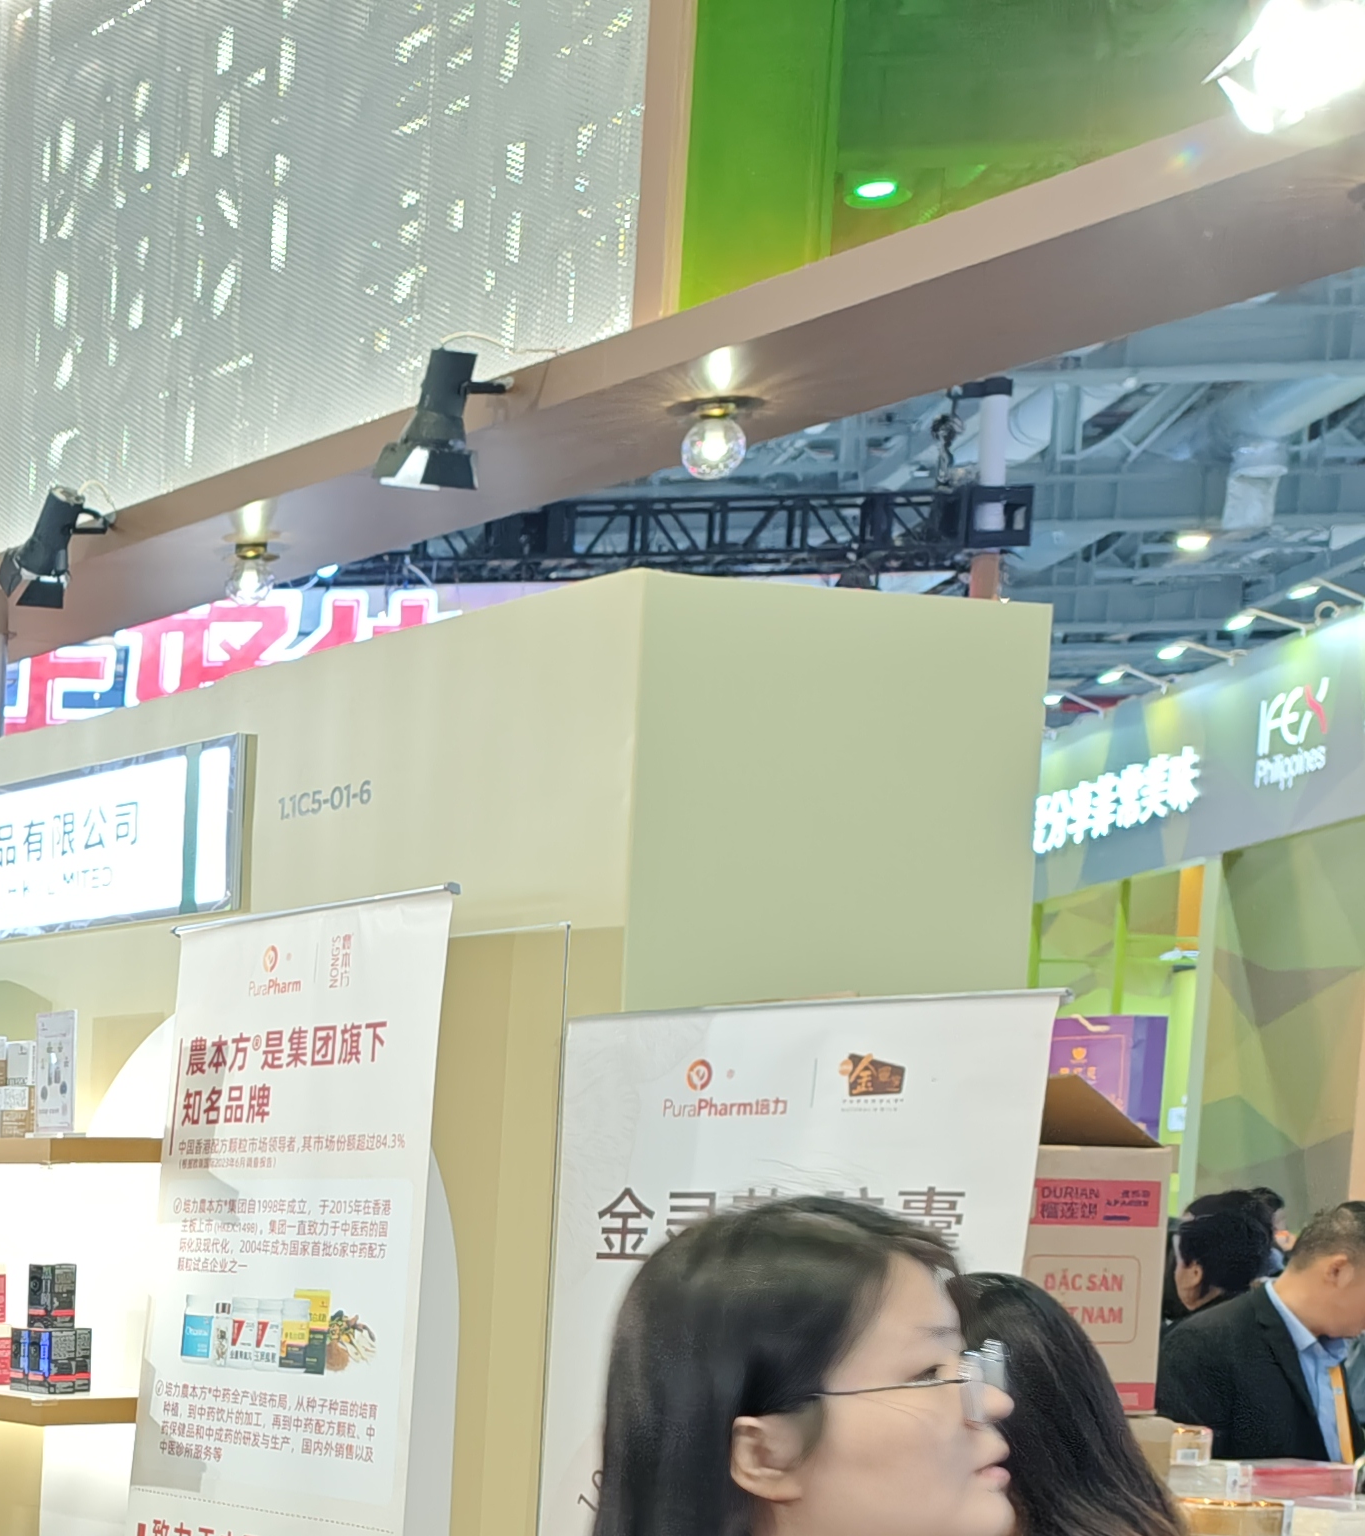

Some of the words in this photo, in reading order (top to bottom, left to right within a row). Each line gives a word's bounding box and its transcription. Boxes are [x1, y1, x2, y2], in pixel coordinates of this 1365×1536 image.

[1254, 744, 1327, 790] Philippines
[278, 779, 372, 821] 1.1C5-01-6
[248, 977, 302, 997] PuraPharm
[181, 1083, 272, 1127] 知名品牌
[1041, 1185, 1100, 1200] DURIAN
[1086, 1267, 1123, 1292] SẢN
[1081, 1306, 1123, 1325] NAM
